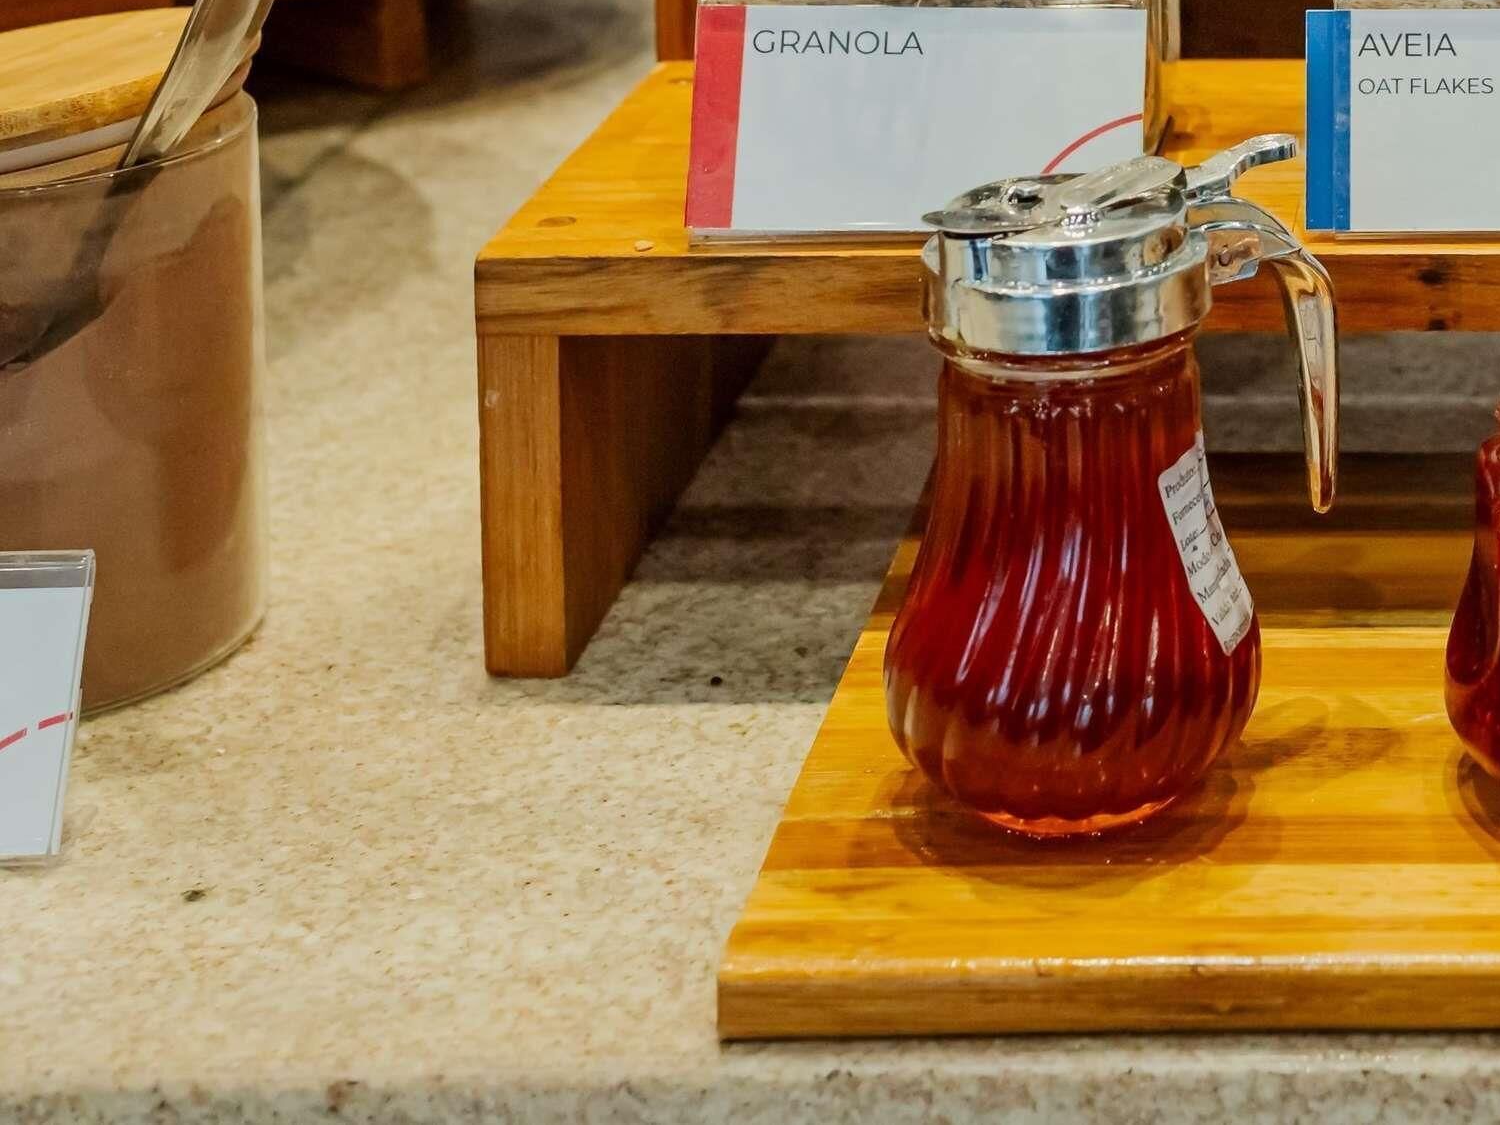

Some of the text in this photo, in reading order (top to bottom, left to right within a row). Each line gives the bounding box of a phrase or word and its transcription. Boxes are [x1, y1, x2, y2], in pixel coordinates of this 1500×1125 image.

[752, 29, 924, 55] GRANOLA
[1358, 32, 1457, 57] AVEIA
[1358, 77, 1494, 95] OAT FLAKES
